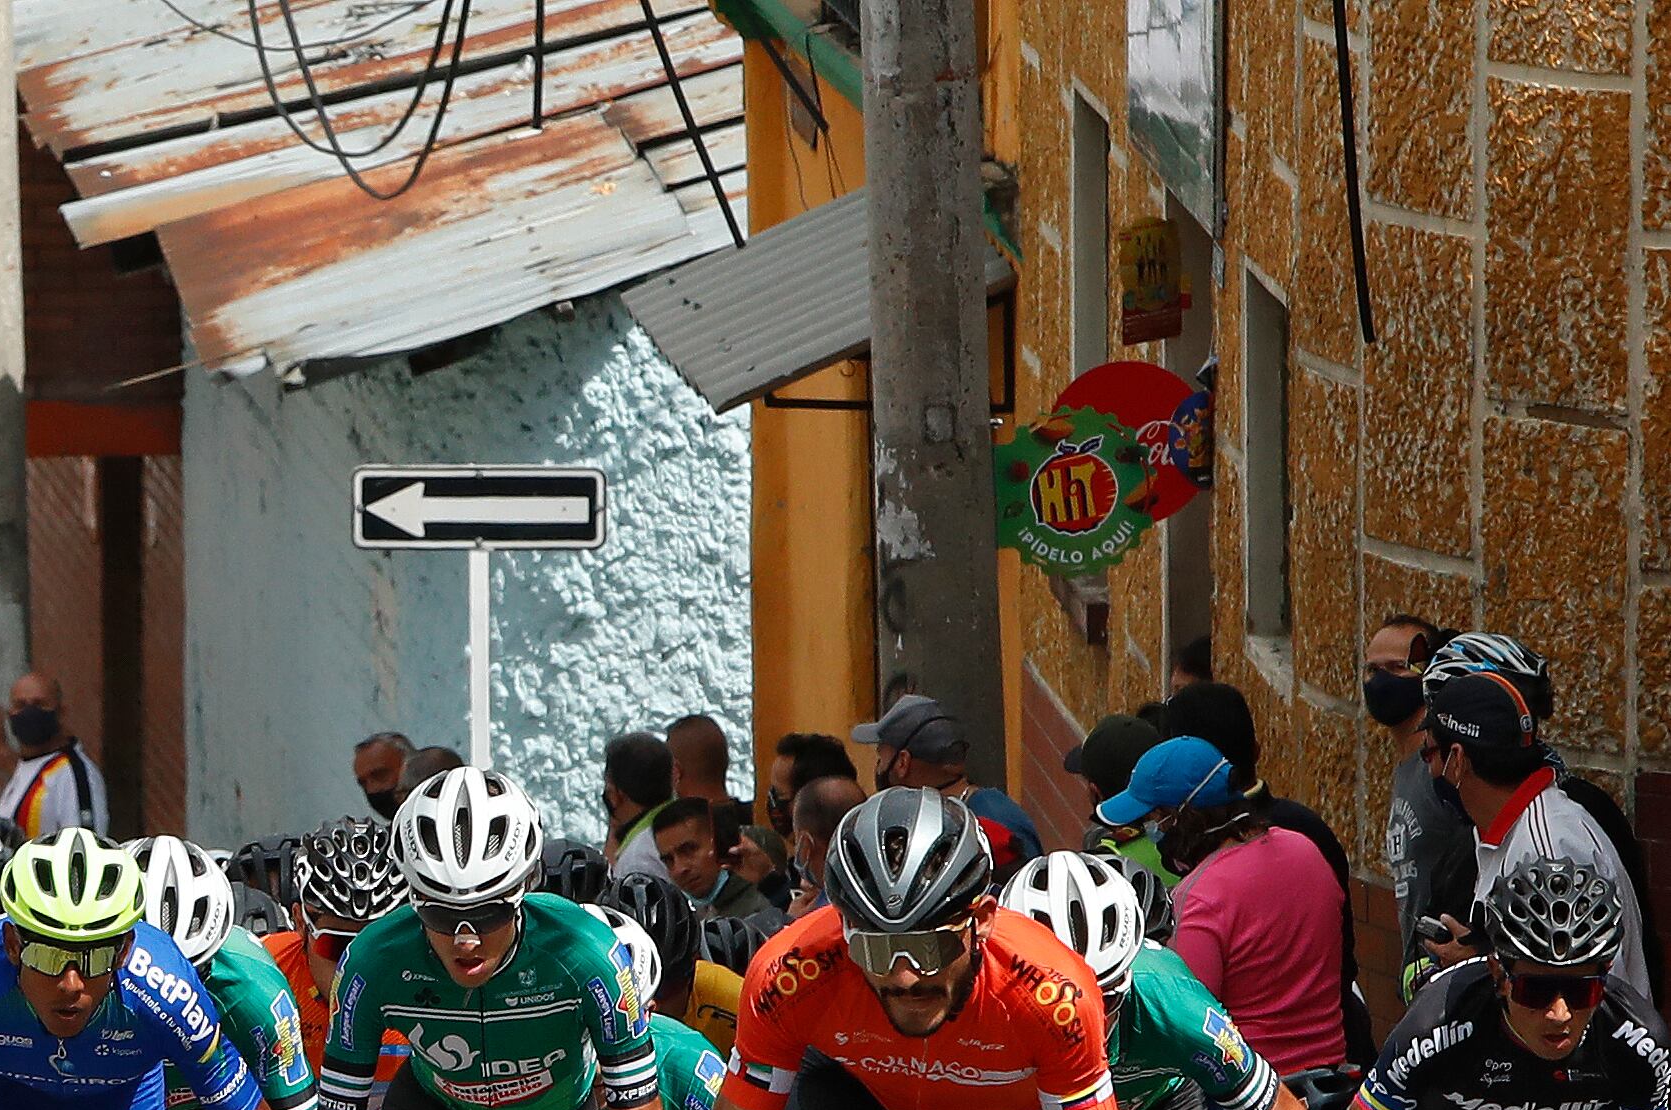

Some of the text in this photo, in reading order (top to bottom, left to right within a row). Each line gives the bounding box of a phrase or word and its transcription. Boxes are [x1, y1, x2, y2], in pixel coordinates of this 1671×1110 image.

[1017, 520, 1135, 564] ¡PÍDELO AQUÍ!
[504, 818, 523, 862] RUDY
[205, 897, 222, 941] RUDY
[1119, 903, 1130, 948] RUDY
[128, 947, 214, 1041] BetPlay
[520, 992, 555, 1005] UNIDOS
[166, 1016, 176, 1028] tu
[481, 1049, 567, 1077] IDEA
[1387, 1020, 1474, 1090] Medellín
[1485, 1059, 1512, 1071] epm
